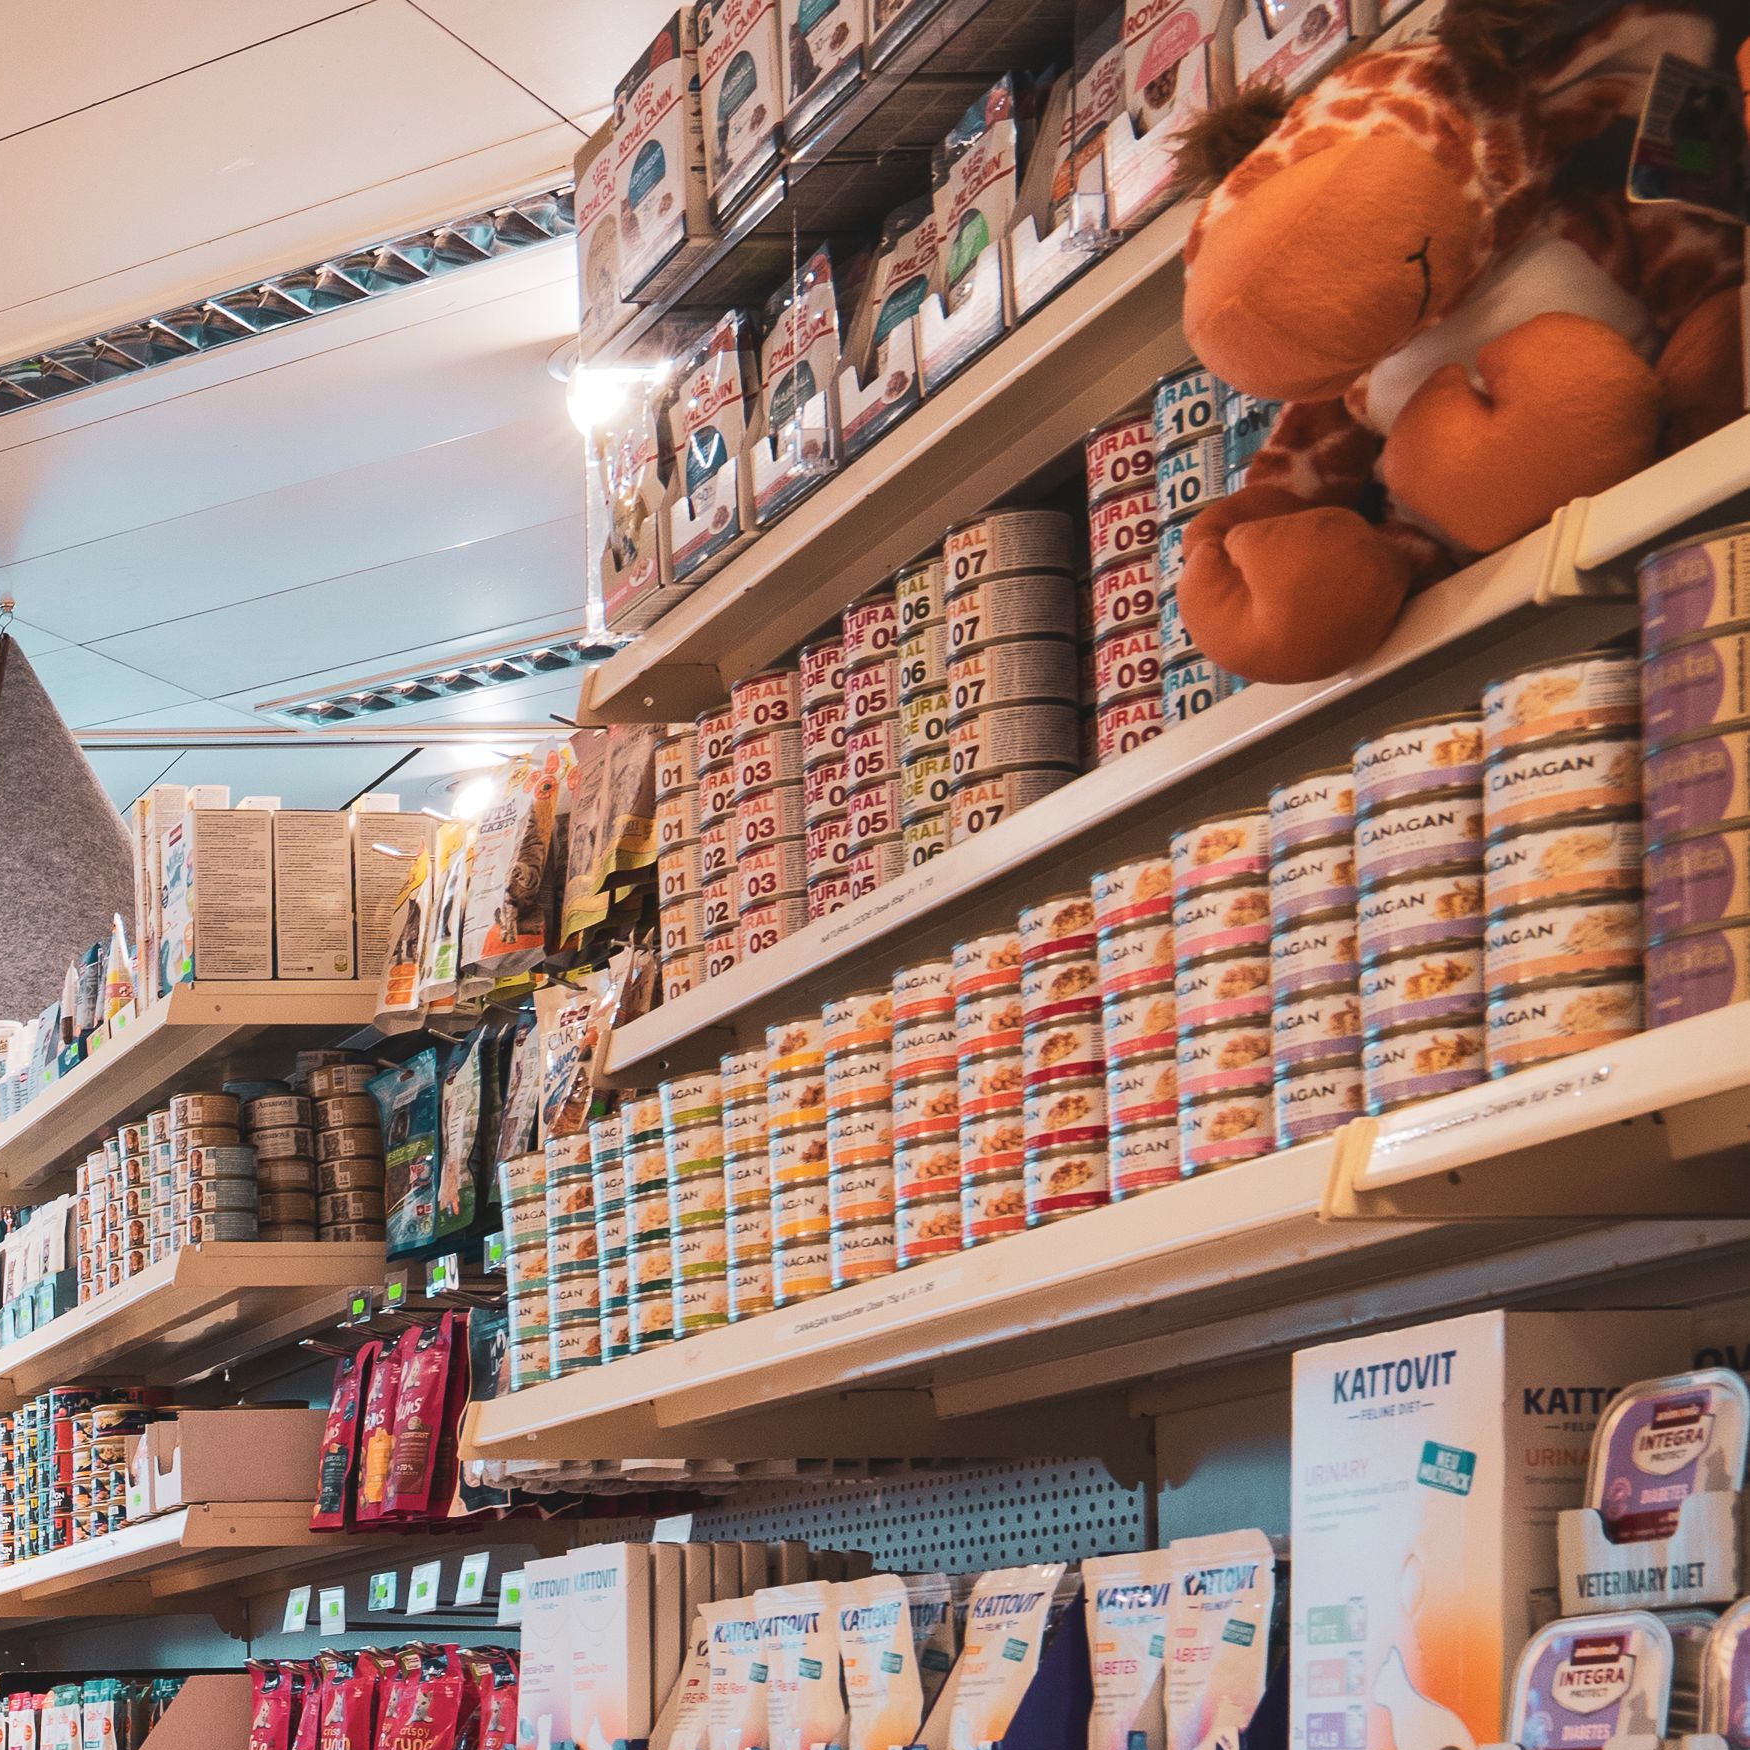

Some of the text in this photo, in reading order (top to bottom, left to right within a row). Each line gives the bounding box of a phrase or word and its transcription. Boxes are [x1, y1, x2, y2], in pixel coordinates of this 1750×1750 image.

[617, 126, 644, 159] ROYAL
[1172, 399, 1211, 435] 10
[1109, 449, 1153, 484] 09
[1114, 517, 1156, 553] 09
[953, 549, 987, 581] 07
[902, 596, 930, 626] 06
[952, 615, 980, 647] 07
[753, 700, 790, 726] 03
[855, 689, 887, 717] 05
[661, 764, 683, 789] 01
[742, 760, 772, 787] 03
[1493, 754, 1596, 793] CANAGAN
[1361, 810, 1457, 849] CANAGAN
[703, 847, 727, 872] 02
[1332, 1350, 1458, 1406] KATTOVIT
[1522, 1386, 1626, 1417] KATTO
[1639, 1425, 1706, 1453] INTEGRA
[1576, 1562, 1706, 1599] VETERINARY DIET
[1559, 1667, 1626, 1688] INTEGRA
